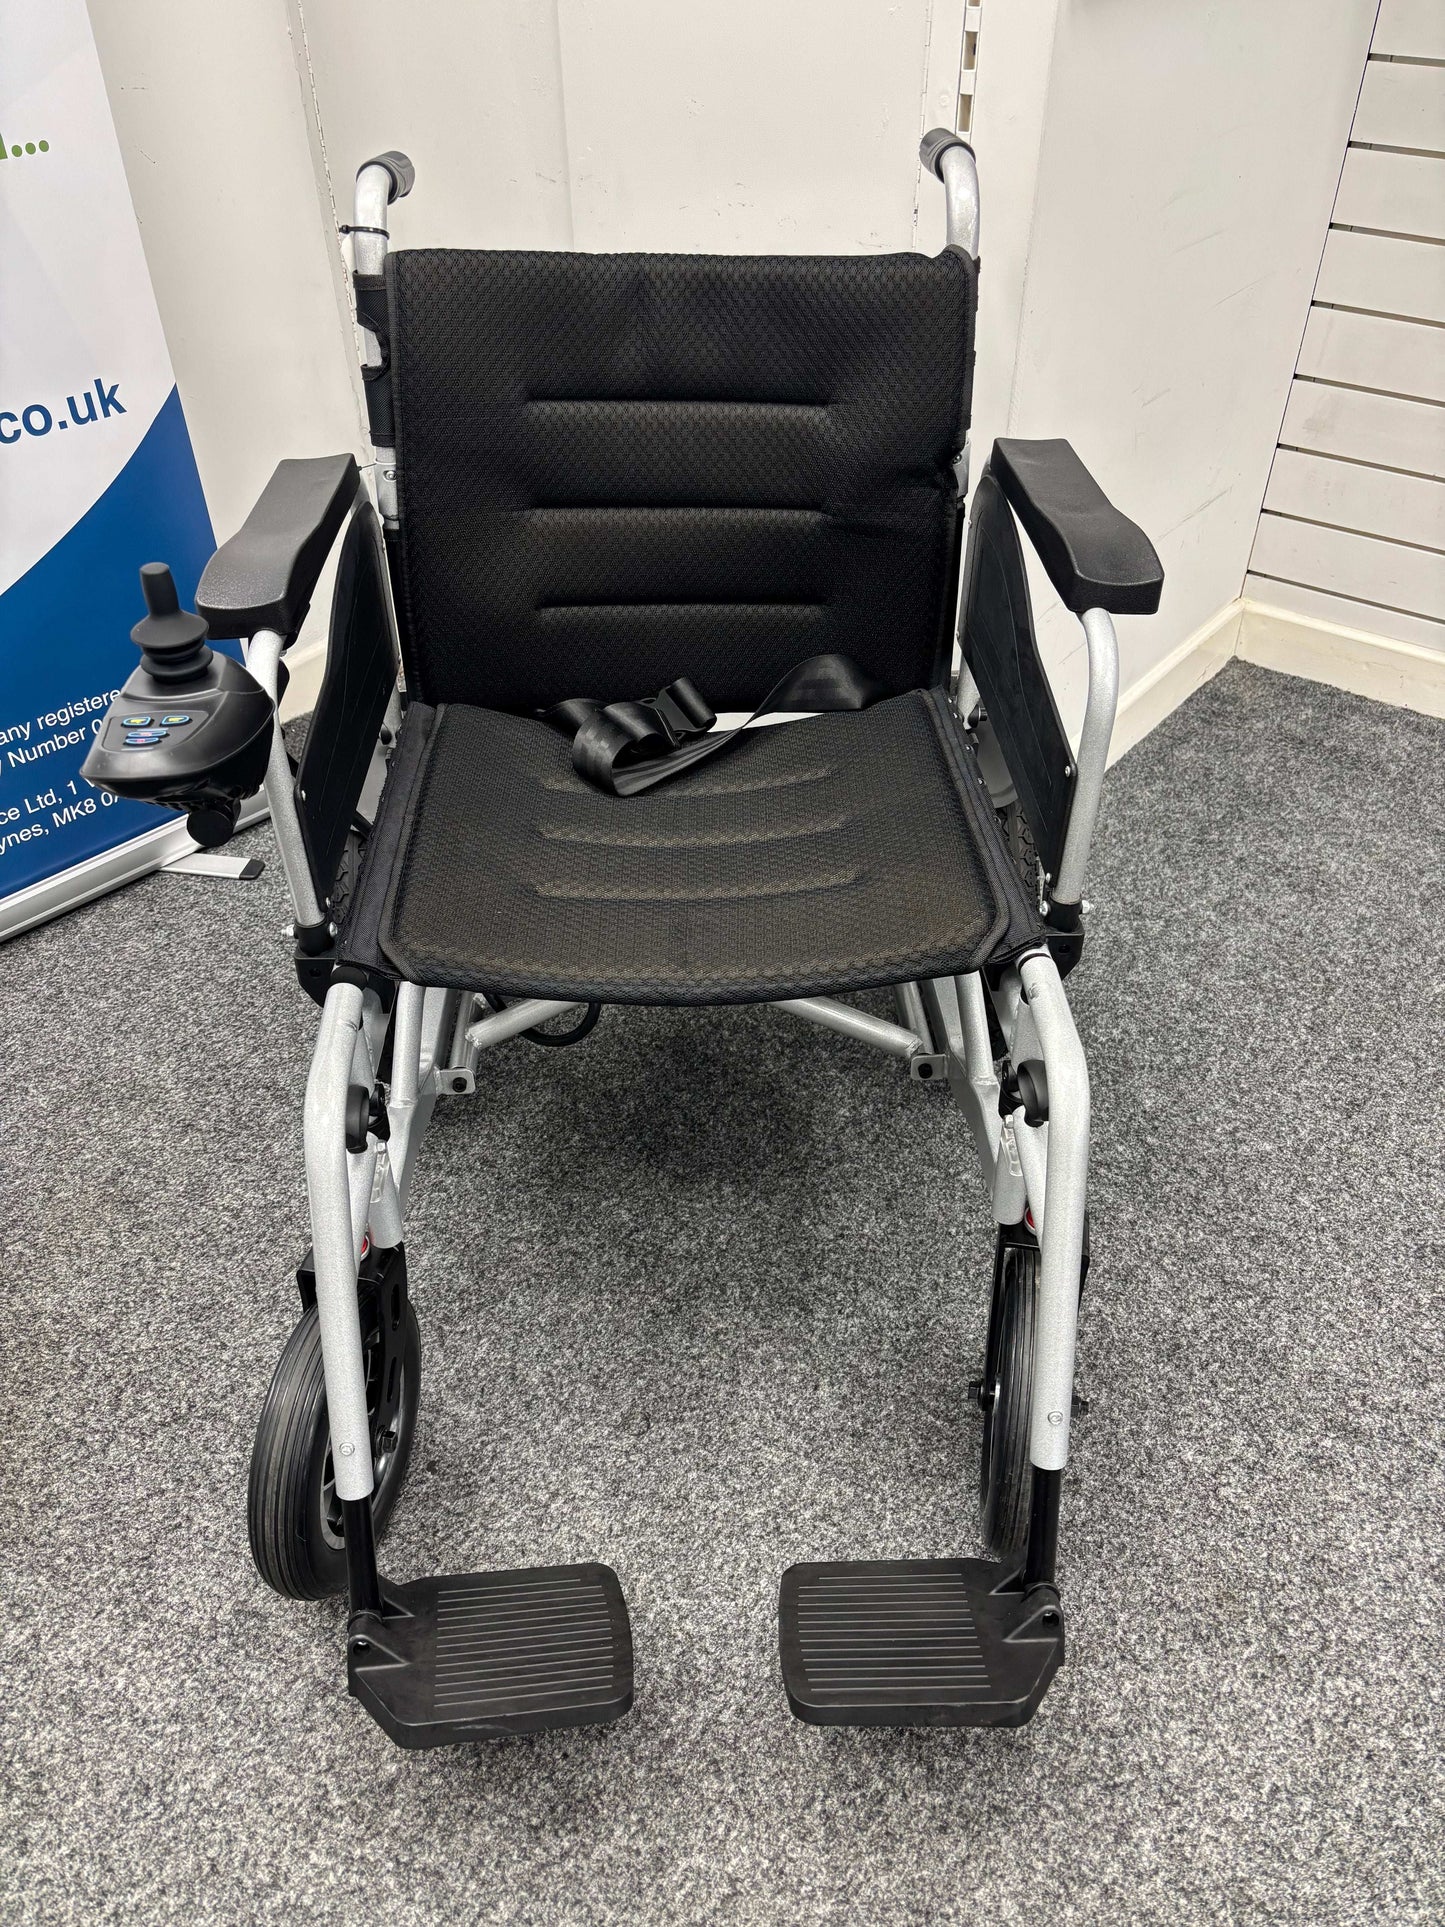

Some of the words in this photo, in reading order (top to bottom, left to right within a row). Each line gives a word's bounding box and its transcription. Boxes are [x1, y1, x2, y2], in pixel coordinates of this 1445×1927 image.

[0, 721, 31, 746] any
[37, 689, 121, 730] registere
[7, 727, 86, 768] Number
[24, 788, 62, 814] Ltd,
[67, 780, 77, 795] 1
[52, 798, 97, 828] MK8
[101, 791, 119, 807] 0
